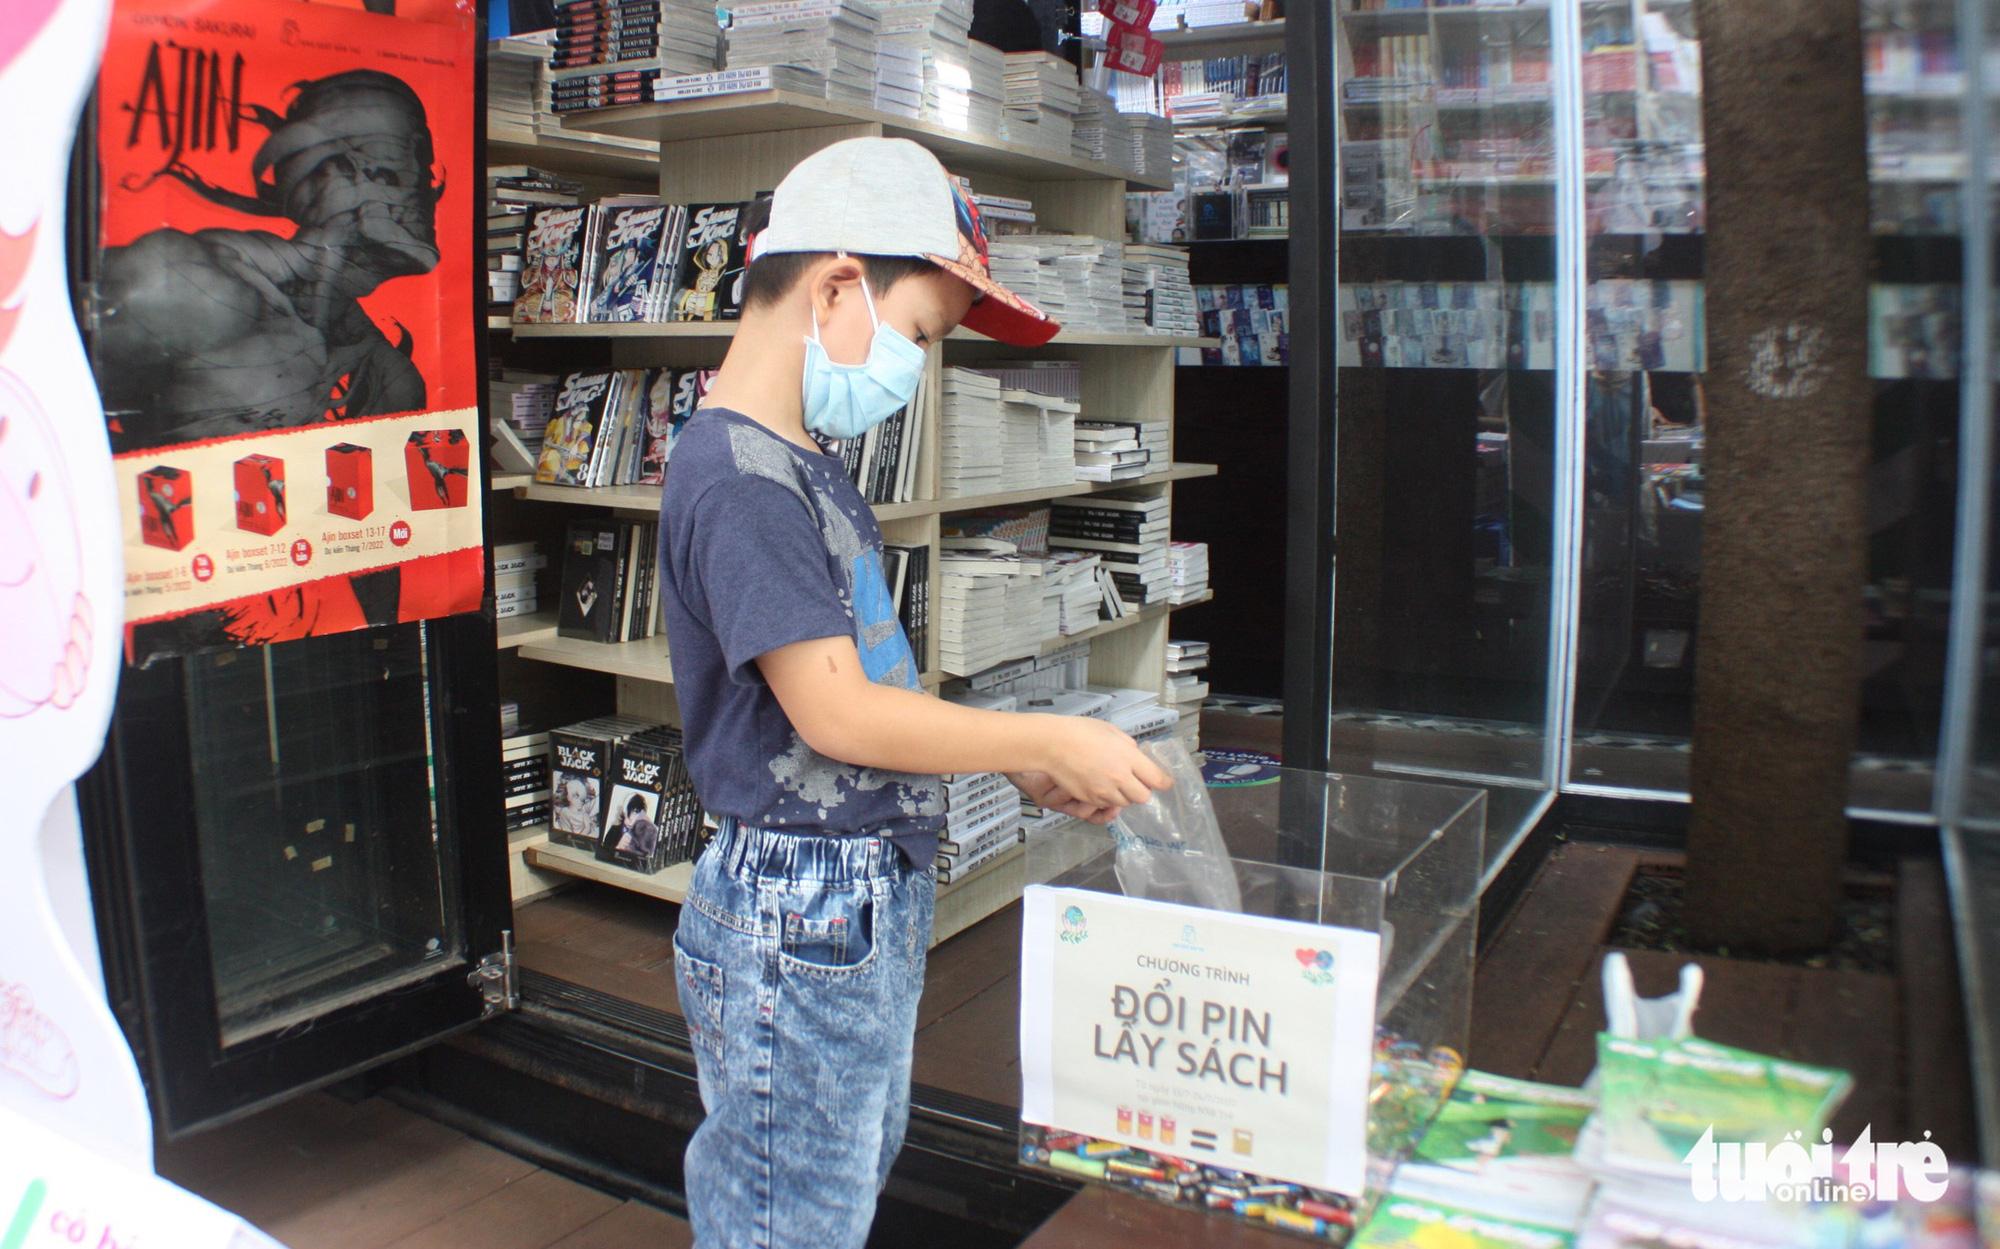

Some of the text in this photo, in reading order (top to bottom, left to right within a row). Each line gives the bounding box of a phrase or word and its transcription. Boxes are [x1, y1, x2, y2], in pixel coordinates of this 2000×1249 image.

[122, 40, 246, 165] AJIN
[563, 301, 575, 319] 3
[576, 464, 589, 482] 8
[322, 526, 386, 543] Ajin boxset 13-17
[393, 528, 408, 539] Mới
[270, 543, 287, 555] 7-12
[361, 541, 384, 550] 7/2022
[557, 745, 596, 762] BLACK
[560, 757, 592, 770] JACK
[622, 758, 661, 777] BLACK
[623, 769, 654, 785] JACK
[1136, 954, 1250, 986] CHƯƠNG TRÌNH
[1111, 977, 1272, 1048] ĐỔI PIN
[1094, 1018, 1289, 1096] LẤY SÁCH
